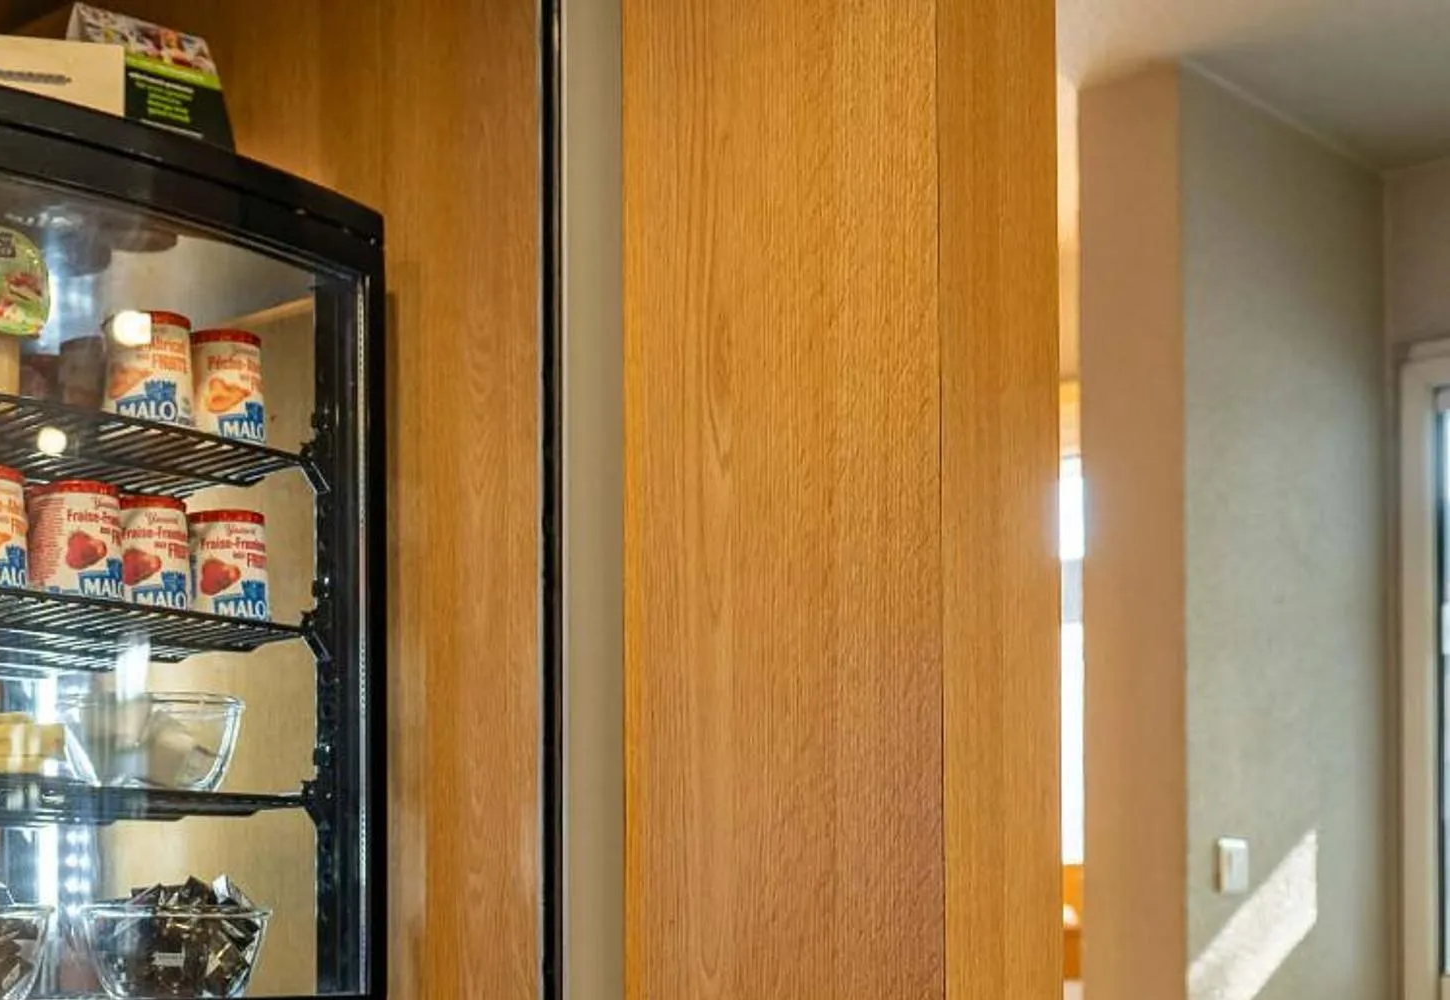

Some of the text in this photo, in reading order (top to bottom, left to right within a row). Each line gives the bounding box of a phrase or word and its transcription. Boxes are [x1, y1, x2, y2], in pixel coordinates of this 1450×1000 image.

[120, 400, 176, 420] MALO
[135, 590, 186, 610] MALO
[218, 600, 266, 618] MALO
